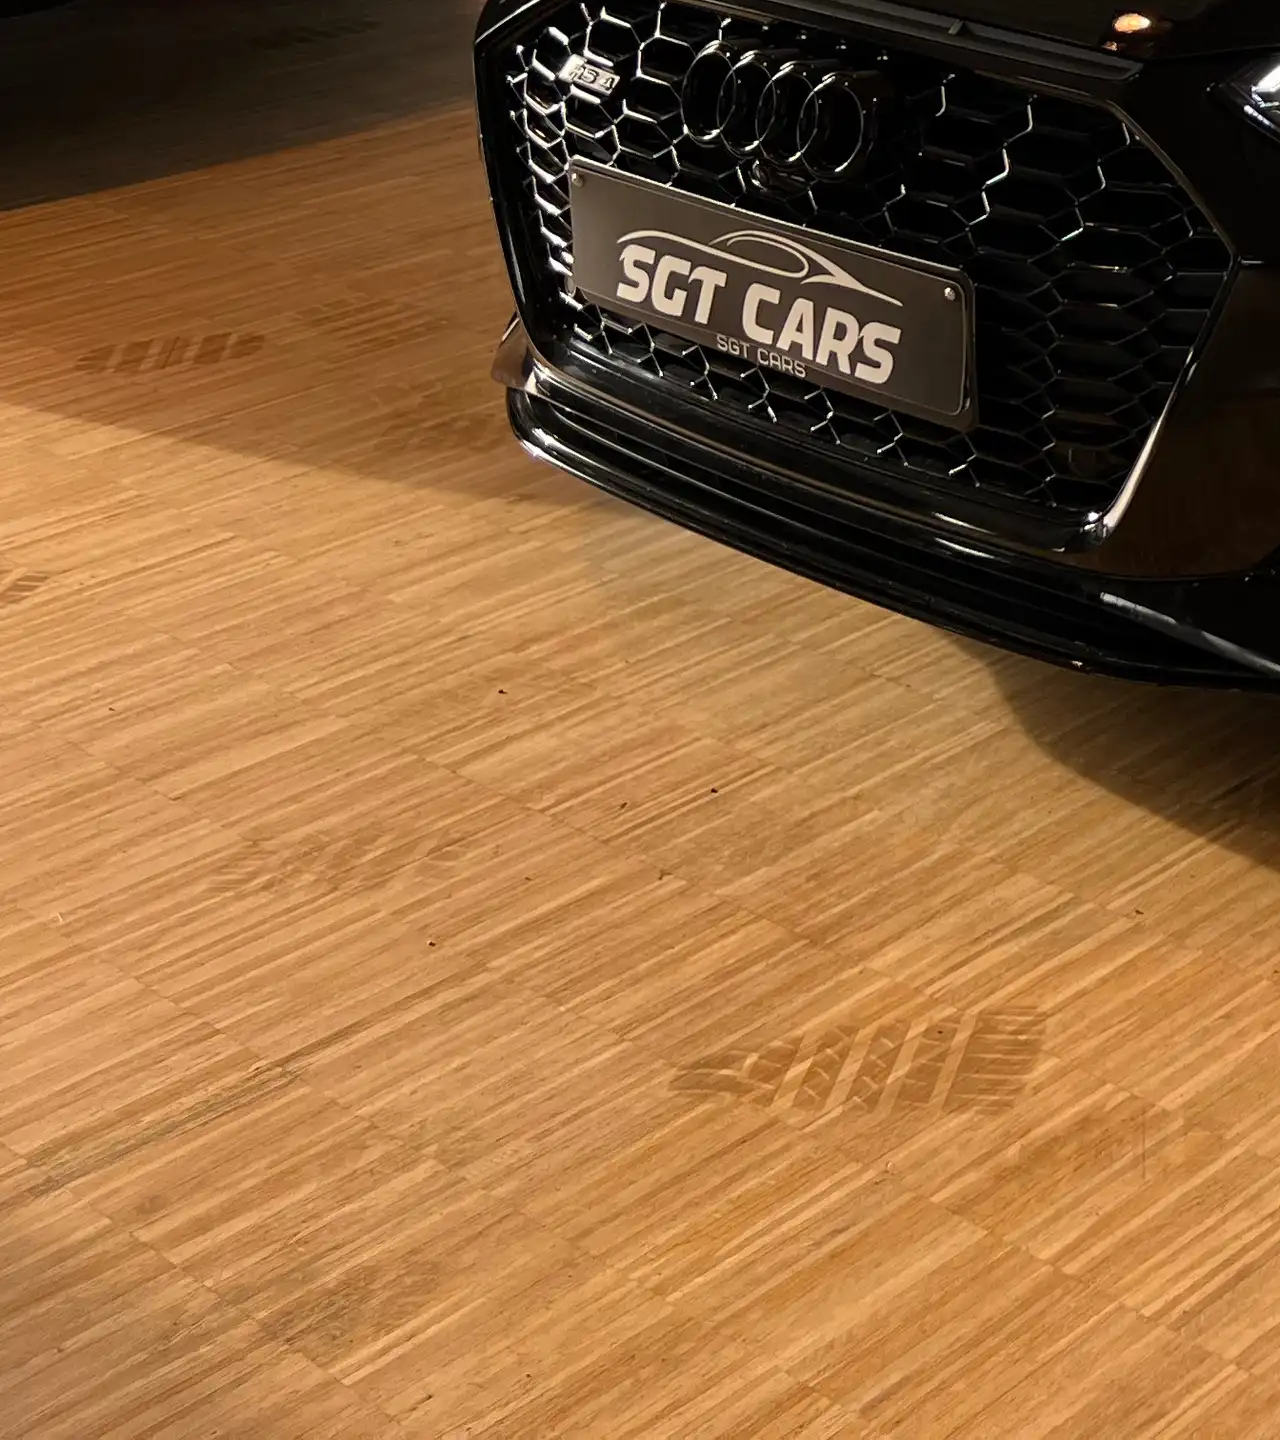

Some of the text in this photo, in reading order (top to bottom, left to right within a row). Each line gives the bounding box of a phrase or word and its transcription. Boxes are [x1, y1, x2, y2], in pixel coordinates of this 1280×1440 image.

[616, 244, 902, 384] SGT CARS
[716, 334, 808, 378] SGT CARS
